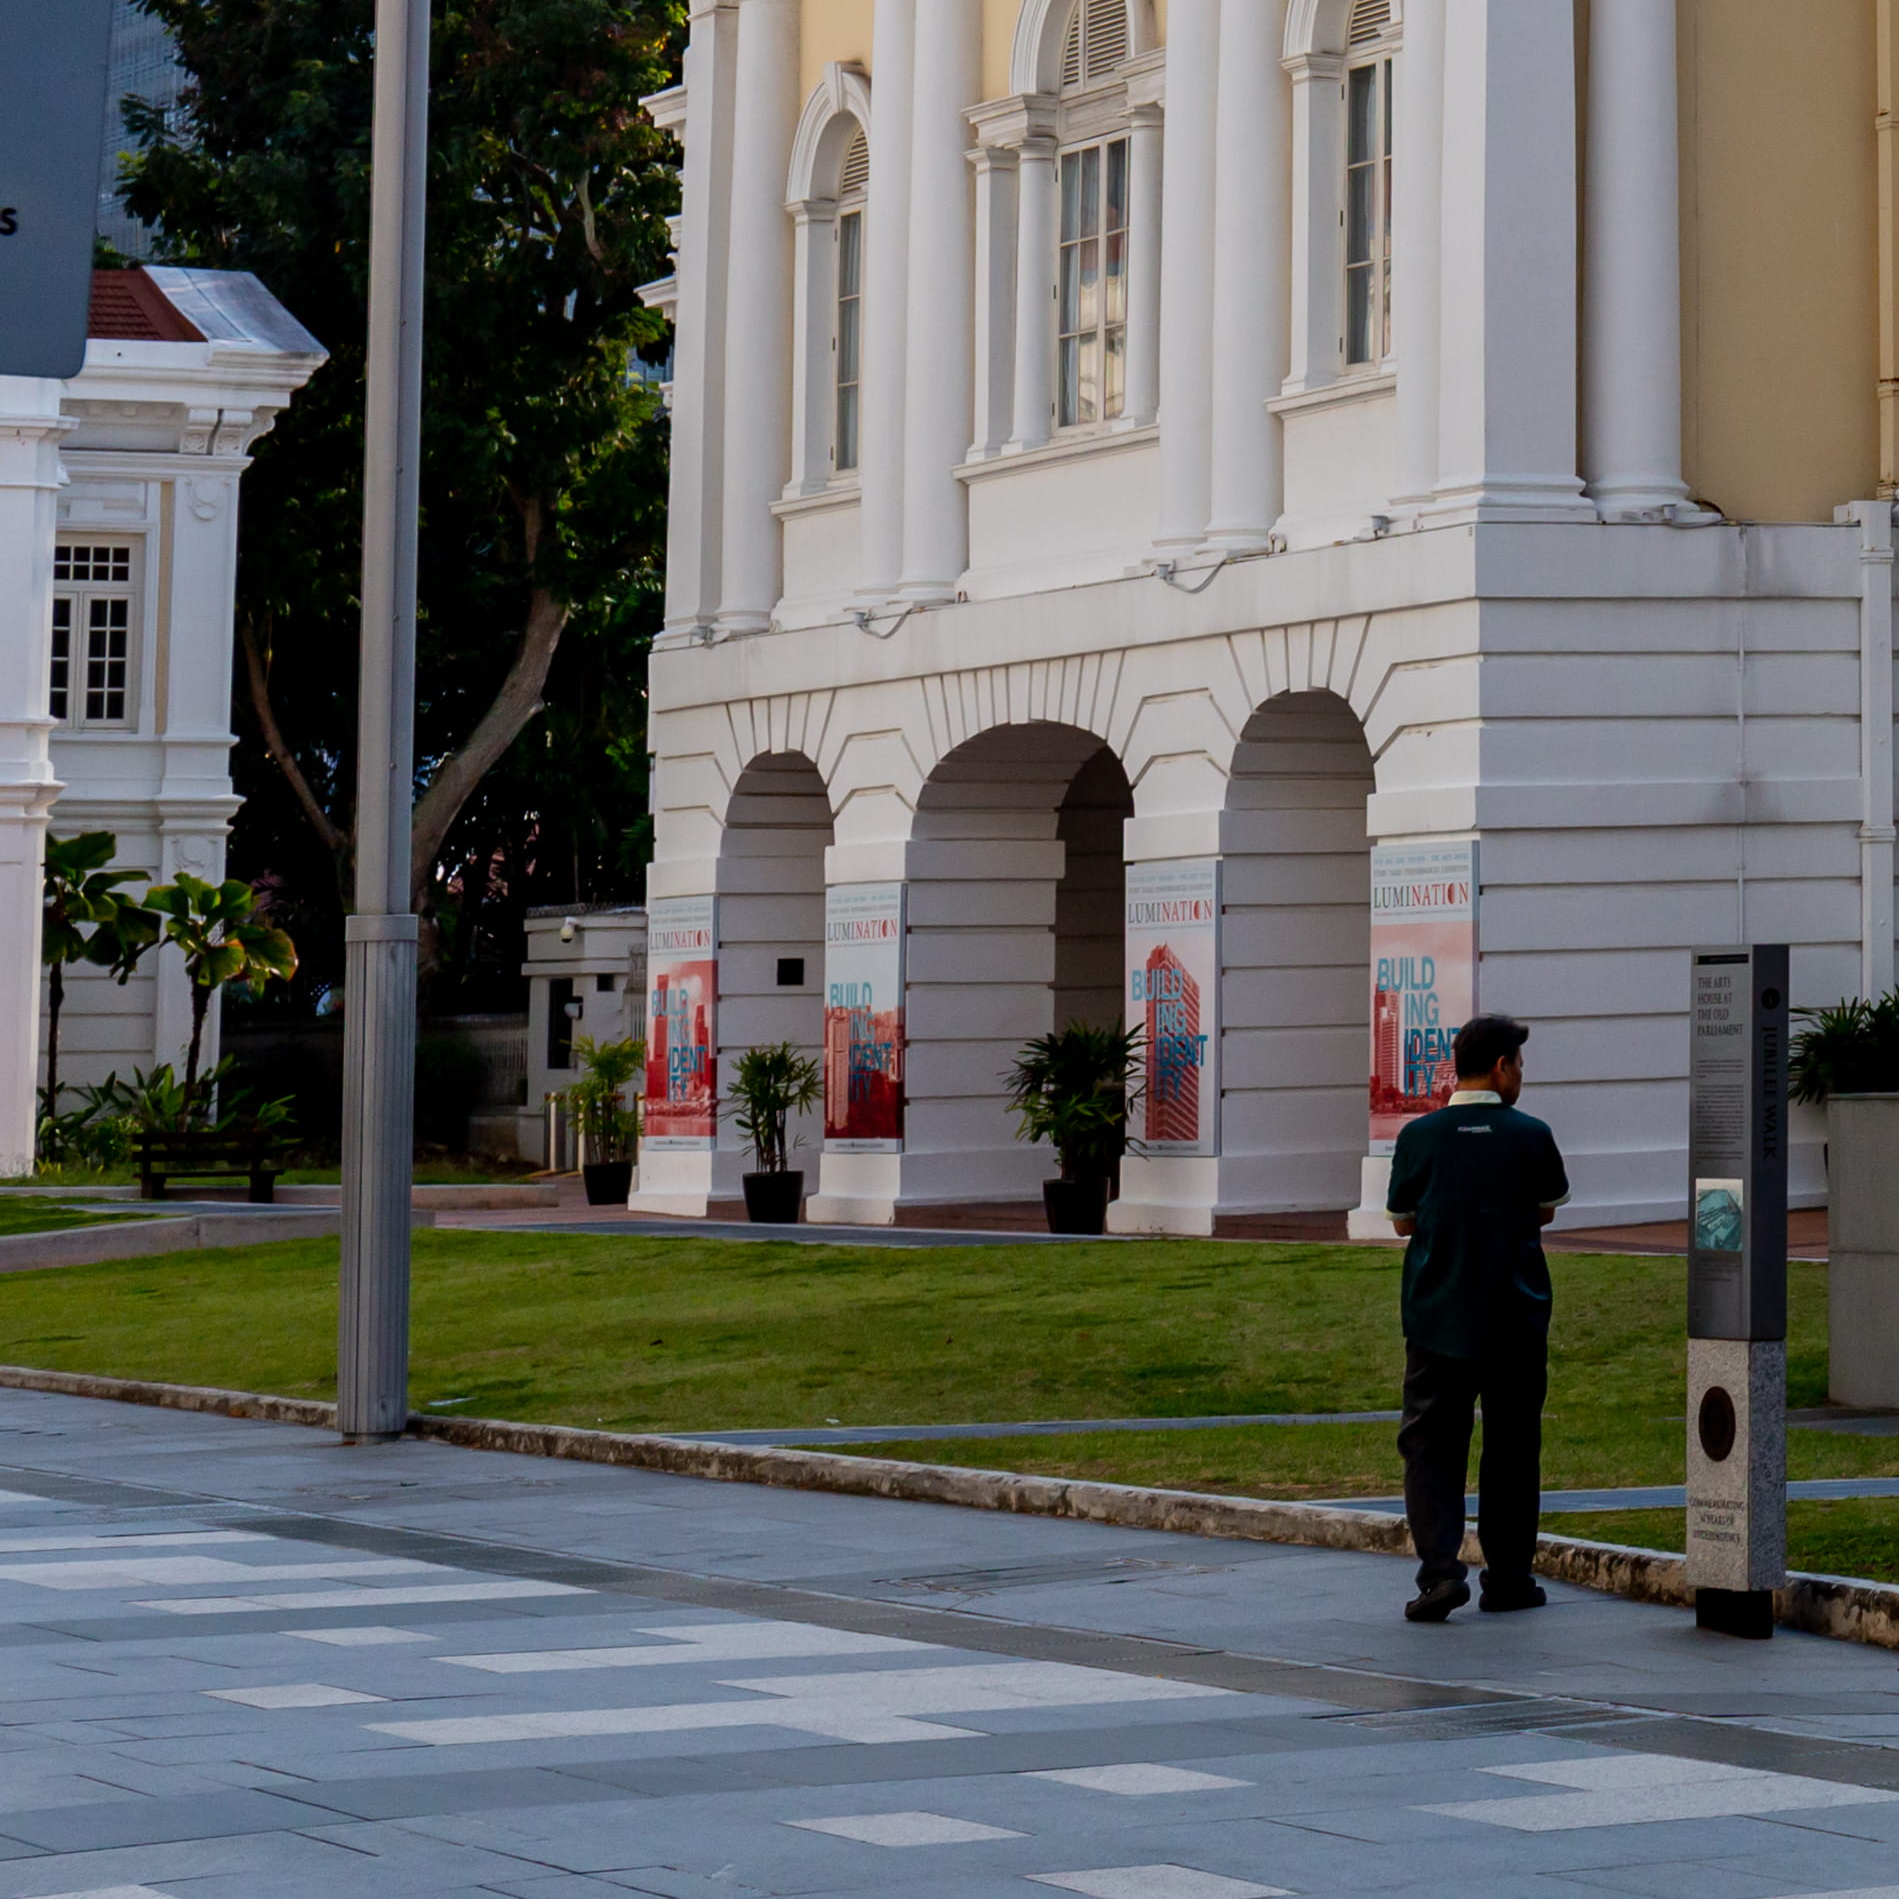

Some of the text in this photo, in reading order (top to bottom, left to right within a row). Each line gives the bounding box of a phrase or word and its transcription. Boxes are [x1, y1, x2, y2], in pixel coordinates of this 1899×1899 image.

[1374, 882, 1468, 909] LUMINATION
[1128, 899, 1212, 924] LUMINATION
[650, 929, 711, 950] LUMINATION
[827, 918, 898, 942] LUMINATION
[1132, 968, 1183, 1001] BUILD
[1377, 956, 1435, 991] BUILD
[652, 989, 688, 1017] BUILD
[830, 982, 872, 1010] BUILD
[1404, 992, 1439, 1026] ING
[669, 1019, 690, 1046] ING
[850, 1013, 875, 1041] ING
[1155, 1002, 1187, 1035] ING
[669, 1046, 707, 1073] IDENT
[849, 1043, 892, 1071] IDENT
[1155, 1035, 1208, 1067] IDENT
